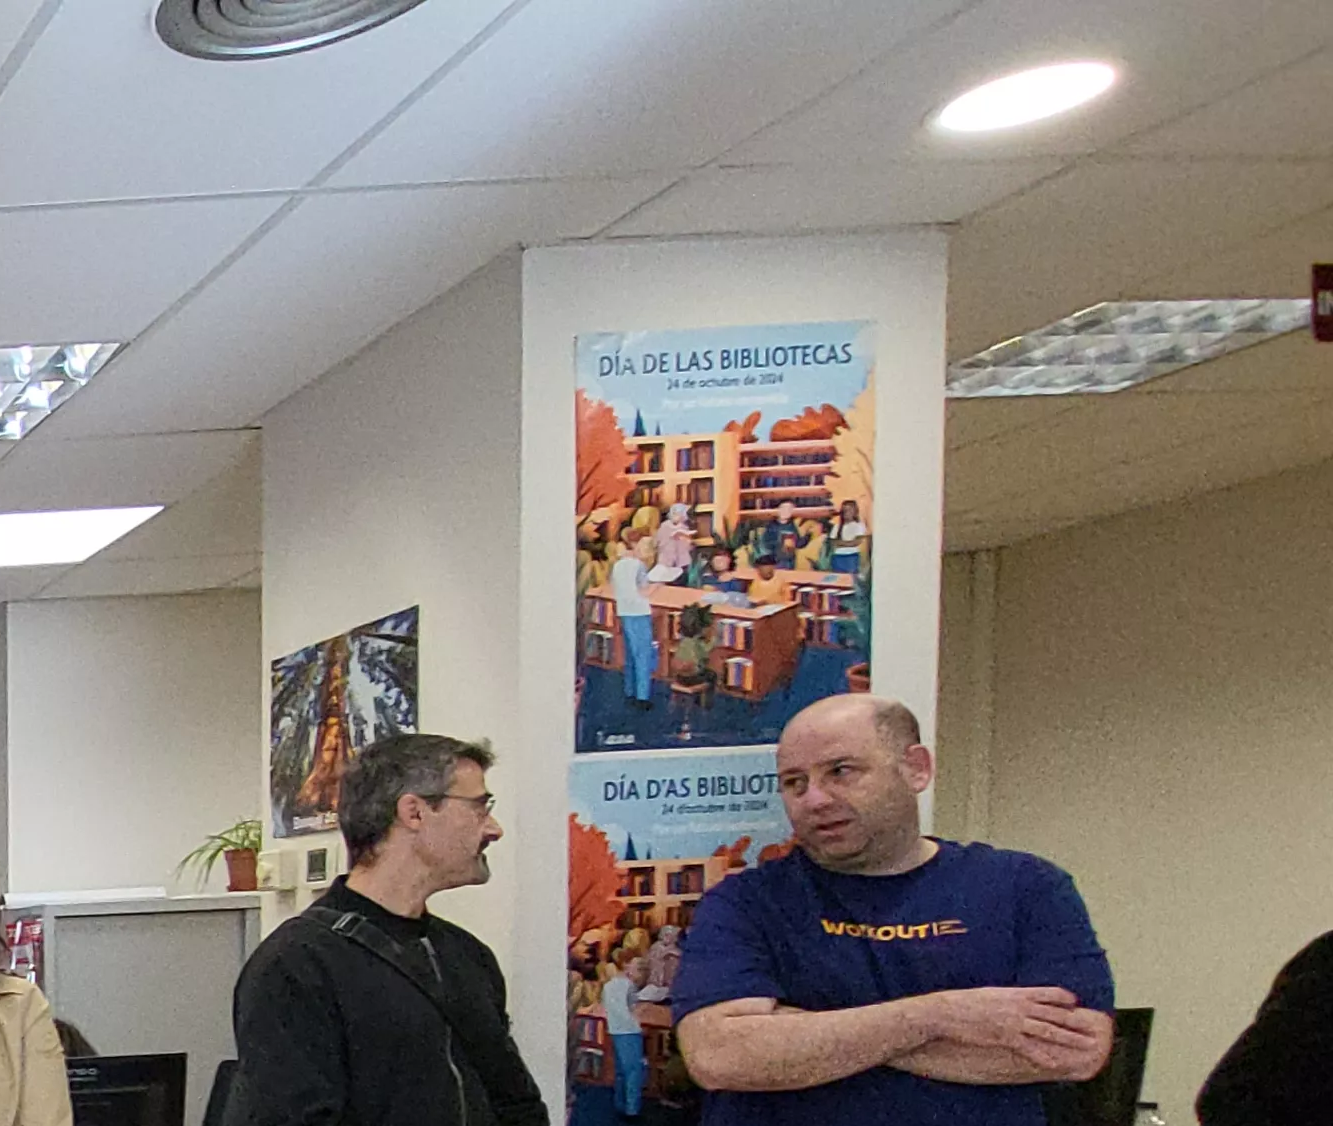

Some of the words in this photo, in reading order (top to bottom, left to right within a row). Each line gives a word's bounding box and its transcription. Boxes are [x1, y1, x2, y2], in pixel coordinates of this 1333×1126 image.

[599, 351, 635, 377] DÍA
[642, 353, 669, 374] DE
[675, 350, 713, 373] LAS
[720, 343, 853, 371] BIBLIOTECAS
[683, 378, 695, 388] de
[699, 376, 741, 388] octubre
[744, 375, 756, 386] de
[603, 773, 640, 801] DÍA
[646, 777, 691, 799] D'AS
[697, 773, 781, 798] BIBLIOT
